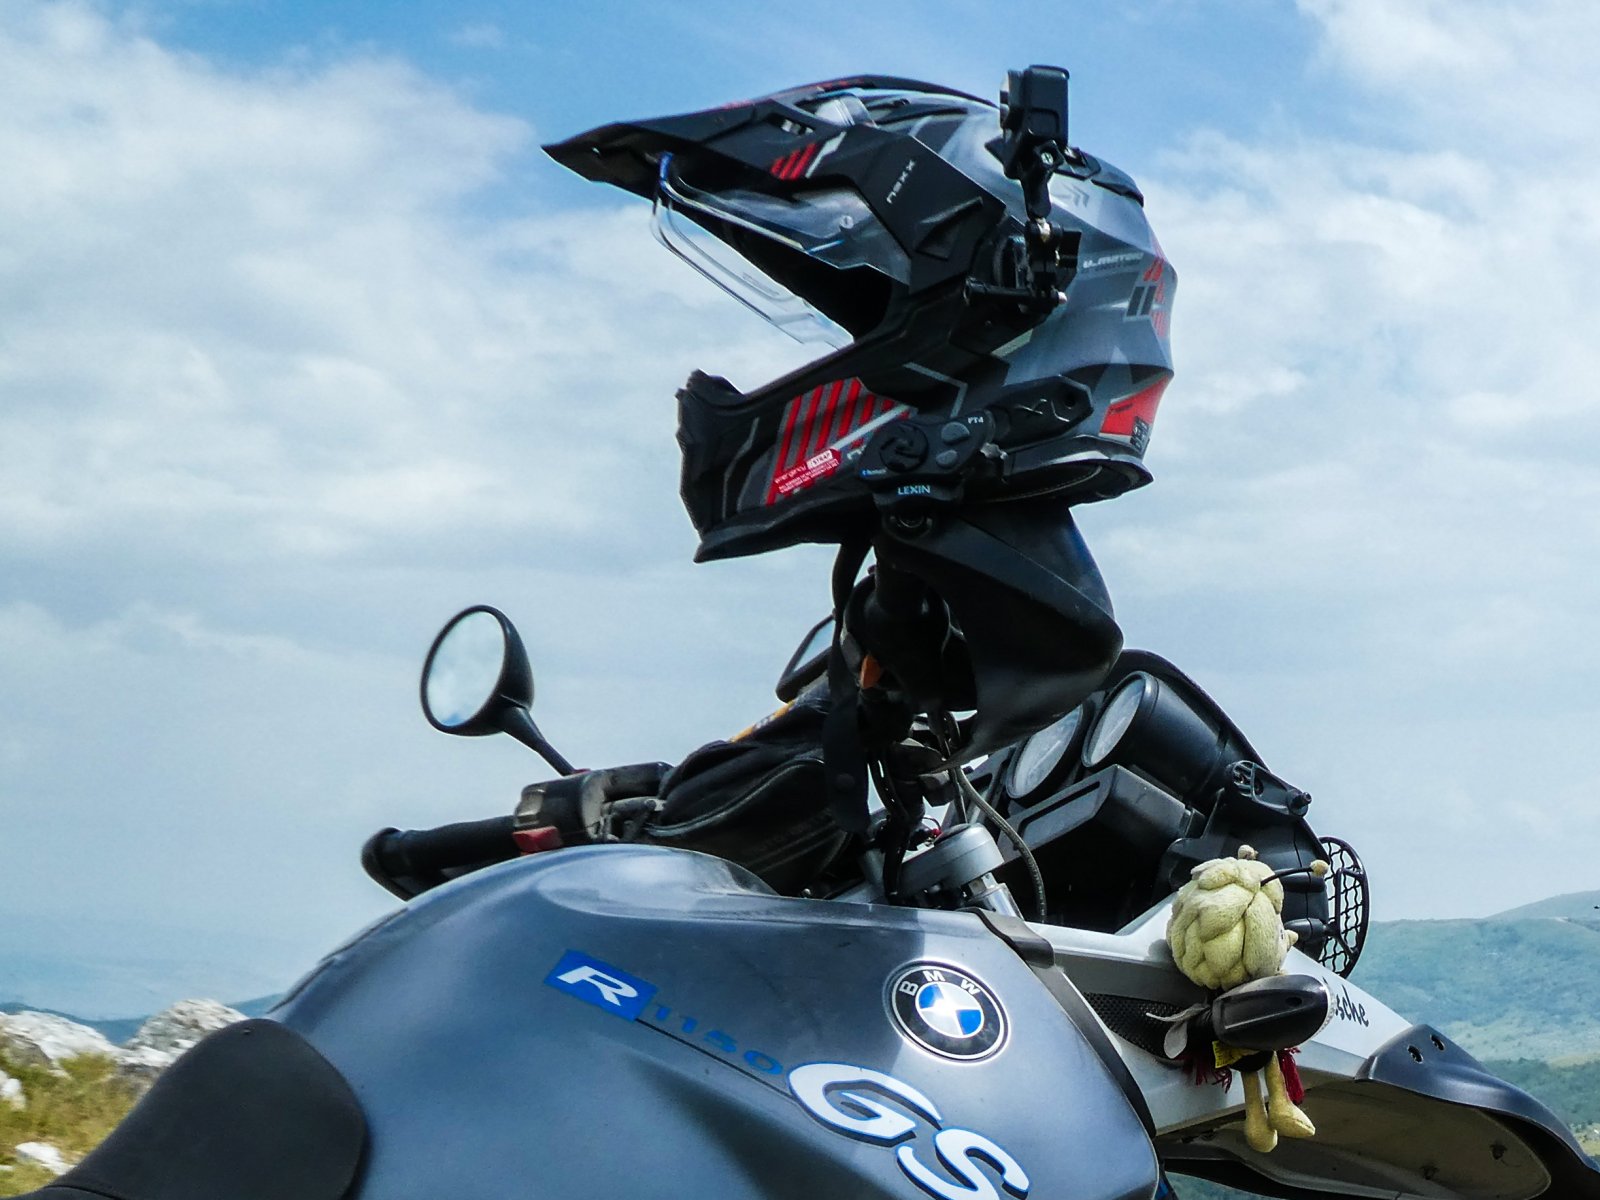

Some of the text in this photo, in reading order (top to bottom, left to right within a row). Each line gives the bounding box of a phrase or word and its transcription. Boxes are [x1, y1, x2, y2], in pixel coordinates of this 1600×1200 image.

[898, 485, 931, 495] LEXIN
[899, 970, 981, 996] BMW
[556, 965, 639, 1007] R
[651, 1001, 784, 1075] 1150
